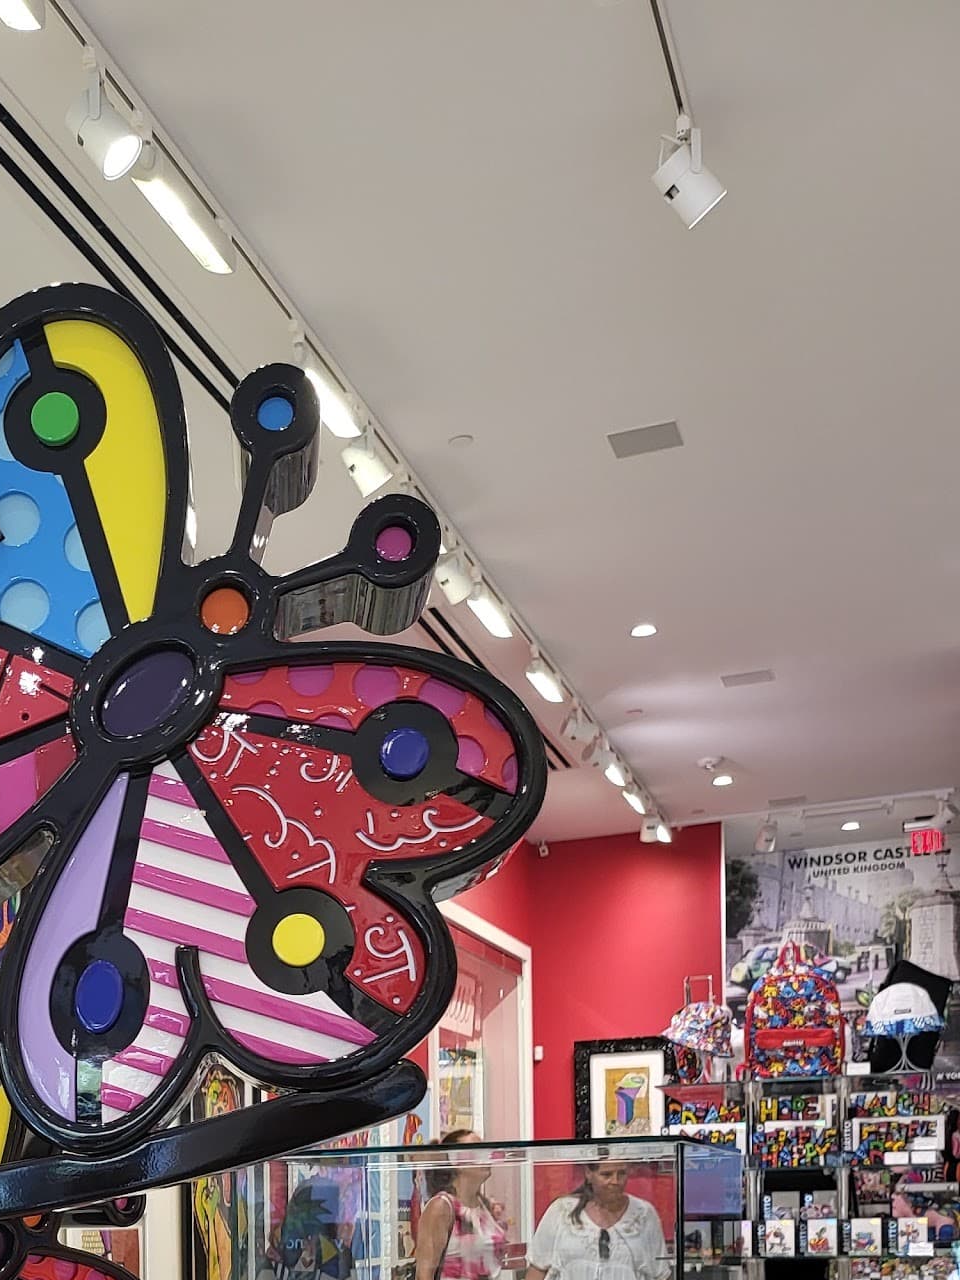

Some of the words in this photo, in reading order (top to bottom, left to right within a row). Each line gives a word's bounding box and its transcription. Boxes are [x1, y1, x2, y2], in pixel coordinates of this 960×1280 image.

[912, 831, 941, 853] EXIT
[788, 850, 867, 870] WINDSOR
[873, 846, 930, 862] CAST
[812, 866, 849, 878] UNITED
[853, 861, 906, 874] KINGDOM
